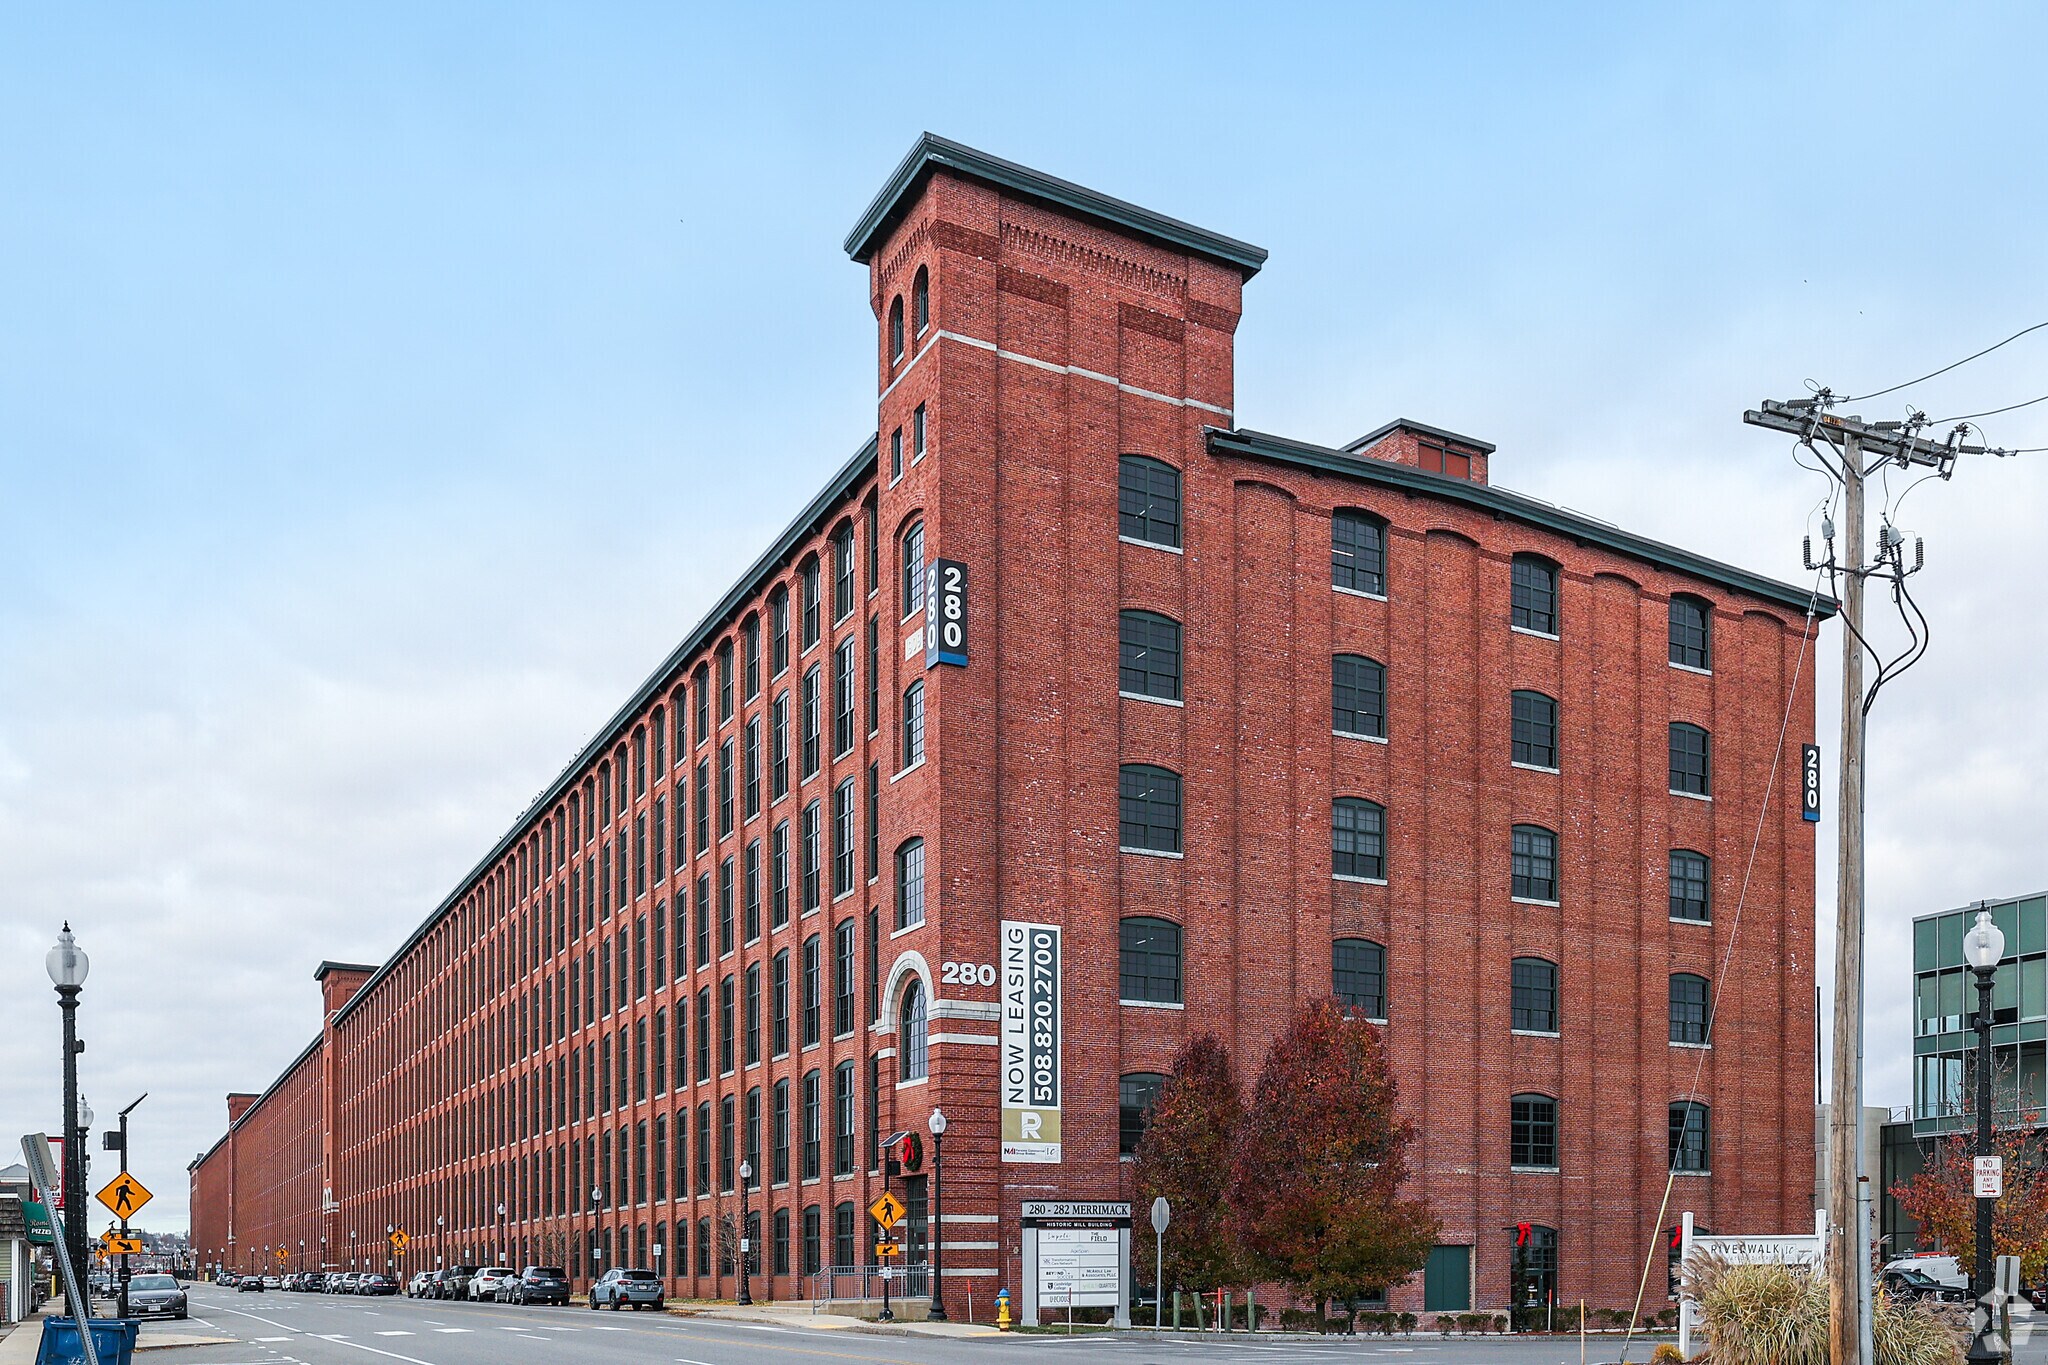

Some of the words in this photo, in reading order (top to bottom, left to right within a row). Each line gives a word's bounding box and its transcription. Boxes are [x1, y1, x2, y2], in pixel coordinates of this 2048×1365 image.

[927, 568, 936, 650] 280
[943, 567, 962, 648] 280
[1807, 749, 1818, 809] 280
[941, 961, 996, 987] 280
[1008, 928, 1024, 1034] LEASING
[1034, 933, 1053, 1101] 508.820.2700
[1008, 1044, 1024, 1103] NOW
[1021, 1111, 1042, 1139] R
[1029, 1204, 1046, 1214] 280
[1054, 1204, 1070, 1214] 282
[1072, 1205, 1128, 1215] MERRIMACK
